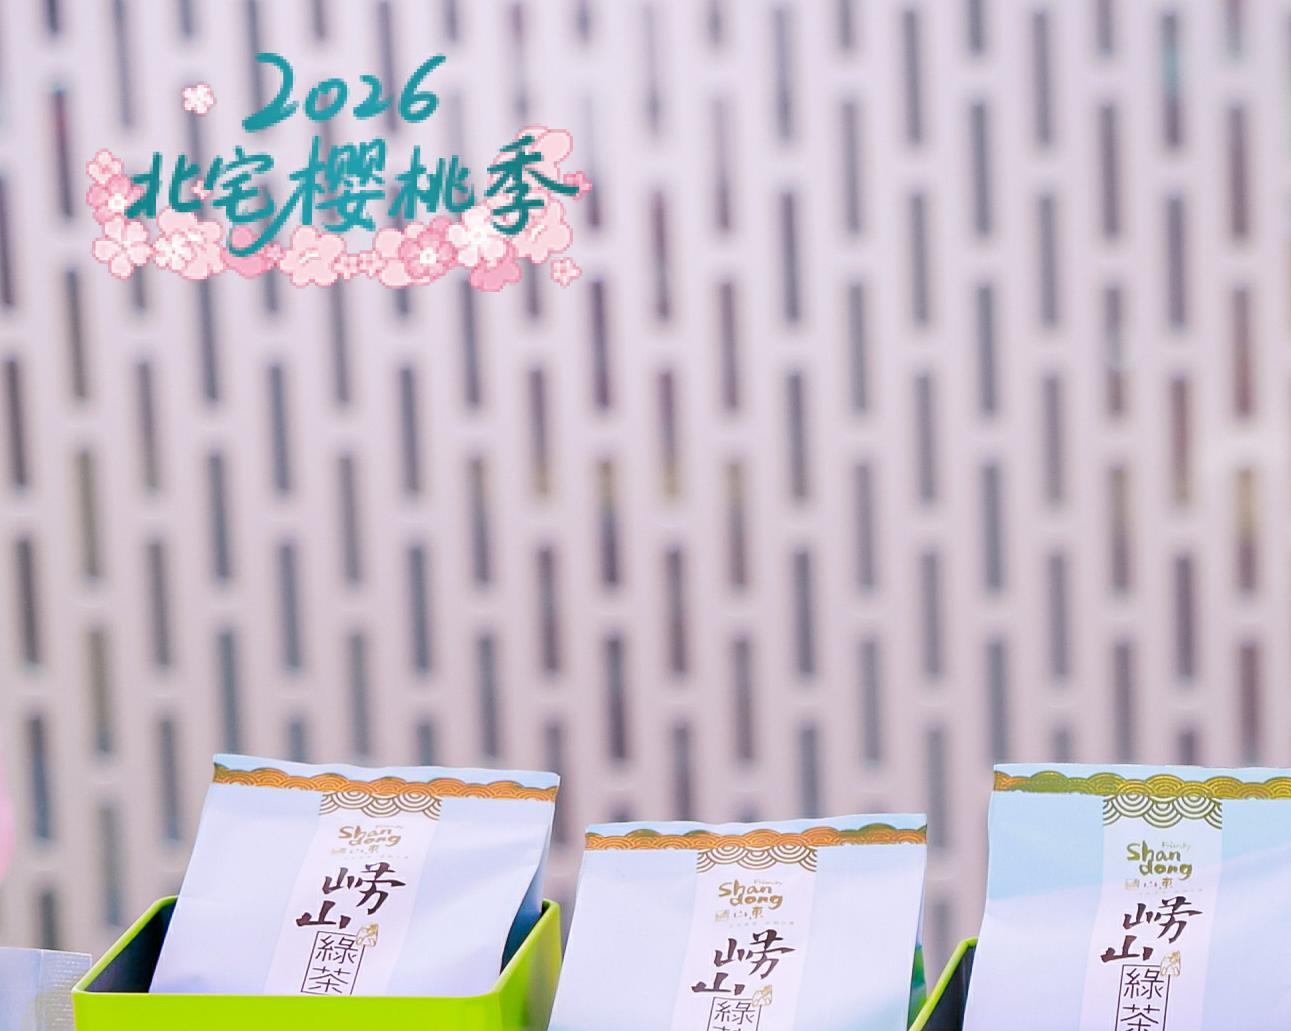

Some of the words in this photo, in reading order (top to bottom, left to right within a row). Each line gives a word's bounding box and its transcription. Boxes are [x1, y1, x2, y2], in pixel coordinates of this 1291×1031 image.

[338, 825, 392, 840] Shan
[1126, 840, 1181, 862] Shan
[1139, 861, 1193, 880] dong
[718, 880, 772, 897] Shan
[729, 891, 784, 909] dong
